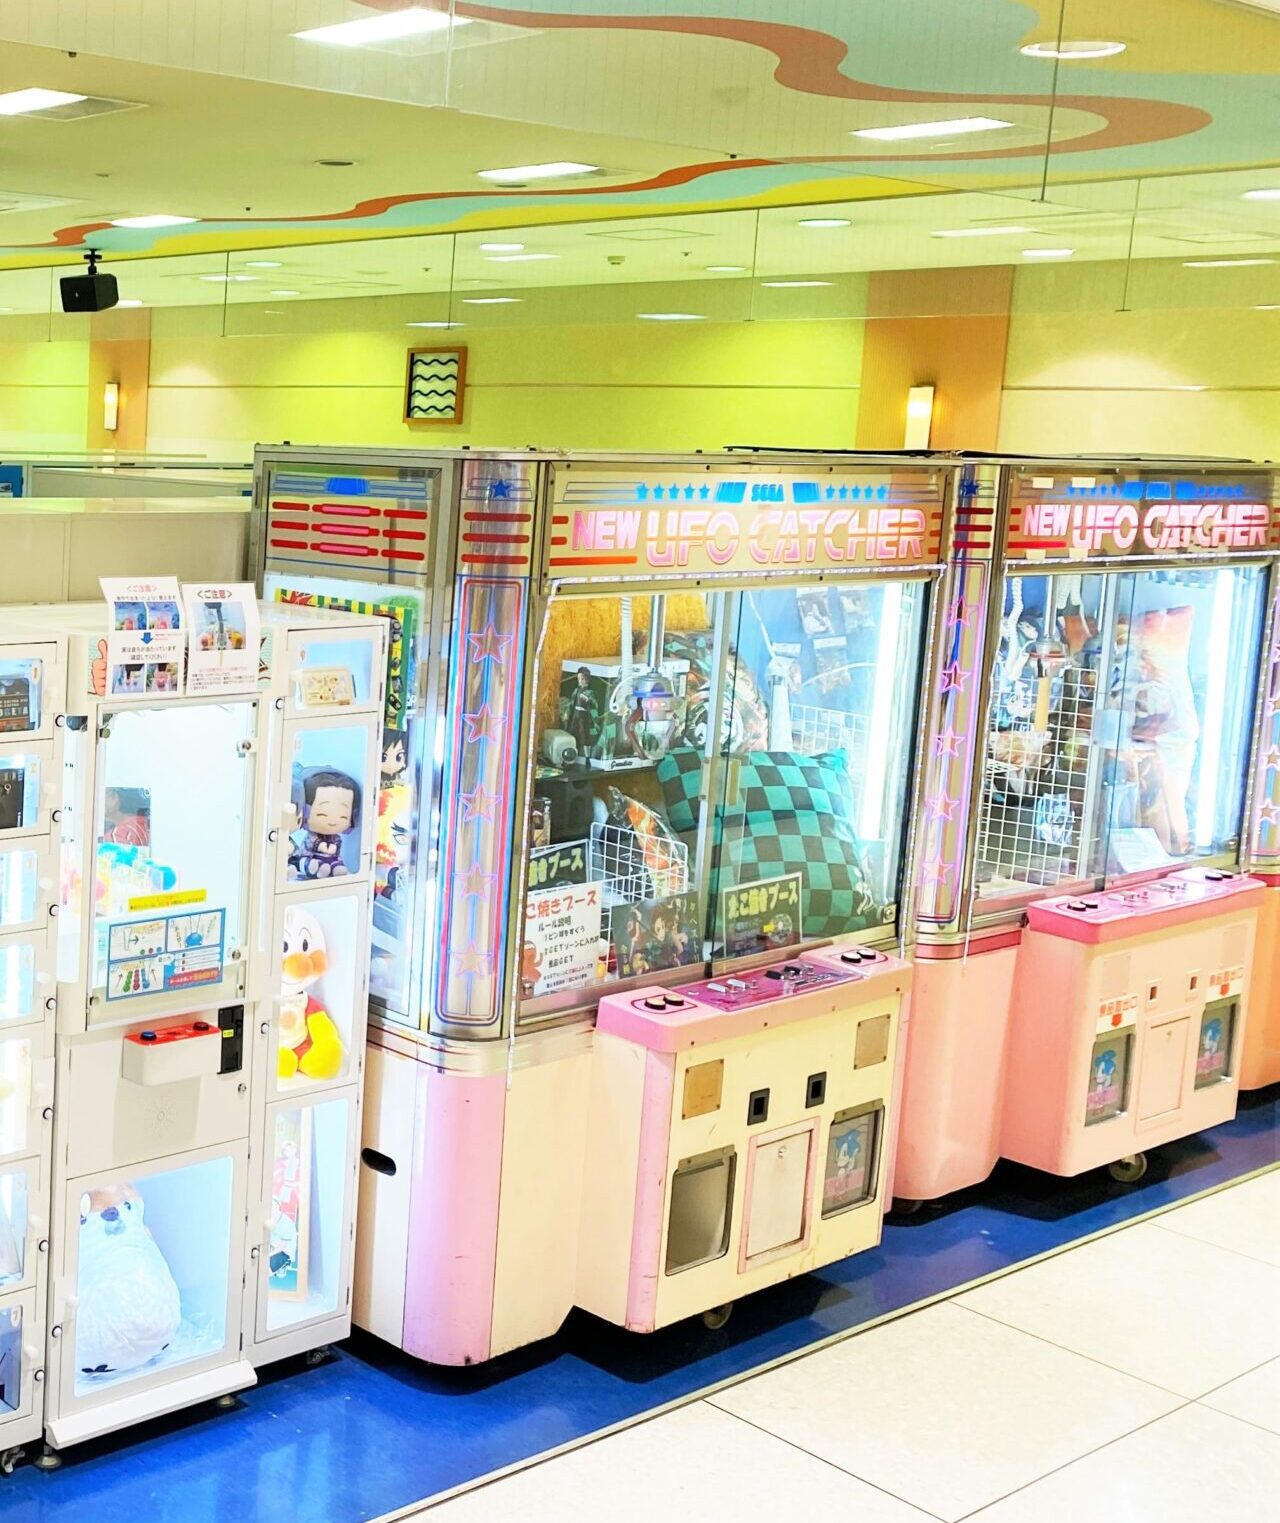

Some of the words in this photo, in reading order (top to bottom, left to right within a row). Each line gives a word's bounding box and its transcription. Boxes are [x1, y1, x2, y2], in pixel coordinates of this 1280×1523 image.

[751, 484, 785, 502] SEGA
[572, 509, 642, 550] NEW
[646, 510, 740, 567] UFO
[748, 508, 927, 563] CATCHER
[1023, 504, 1071, 537] NEW
[1072, 504, 1139, 550] UFO
[1143, 504, 1270, 549] CATCHER
[728, 881, 798, 919] たこ焼きブース
